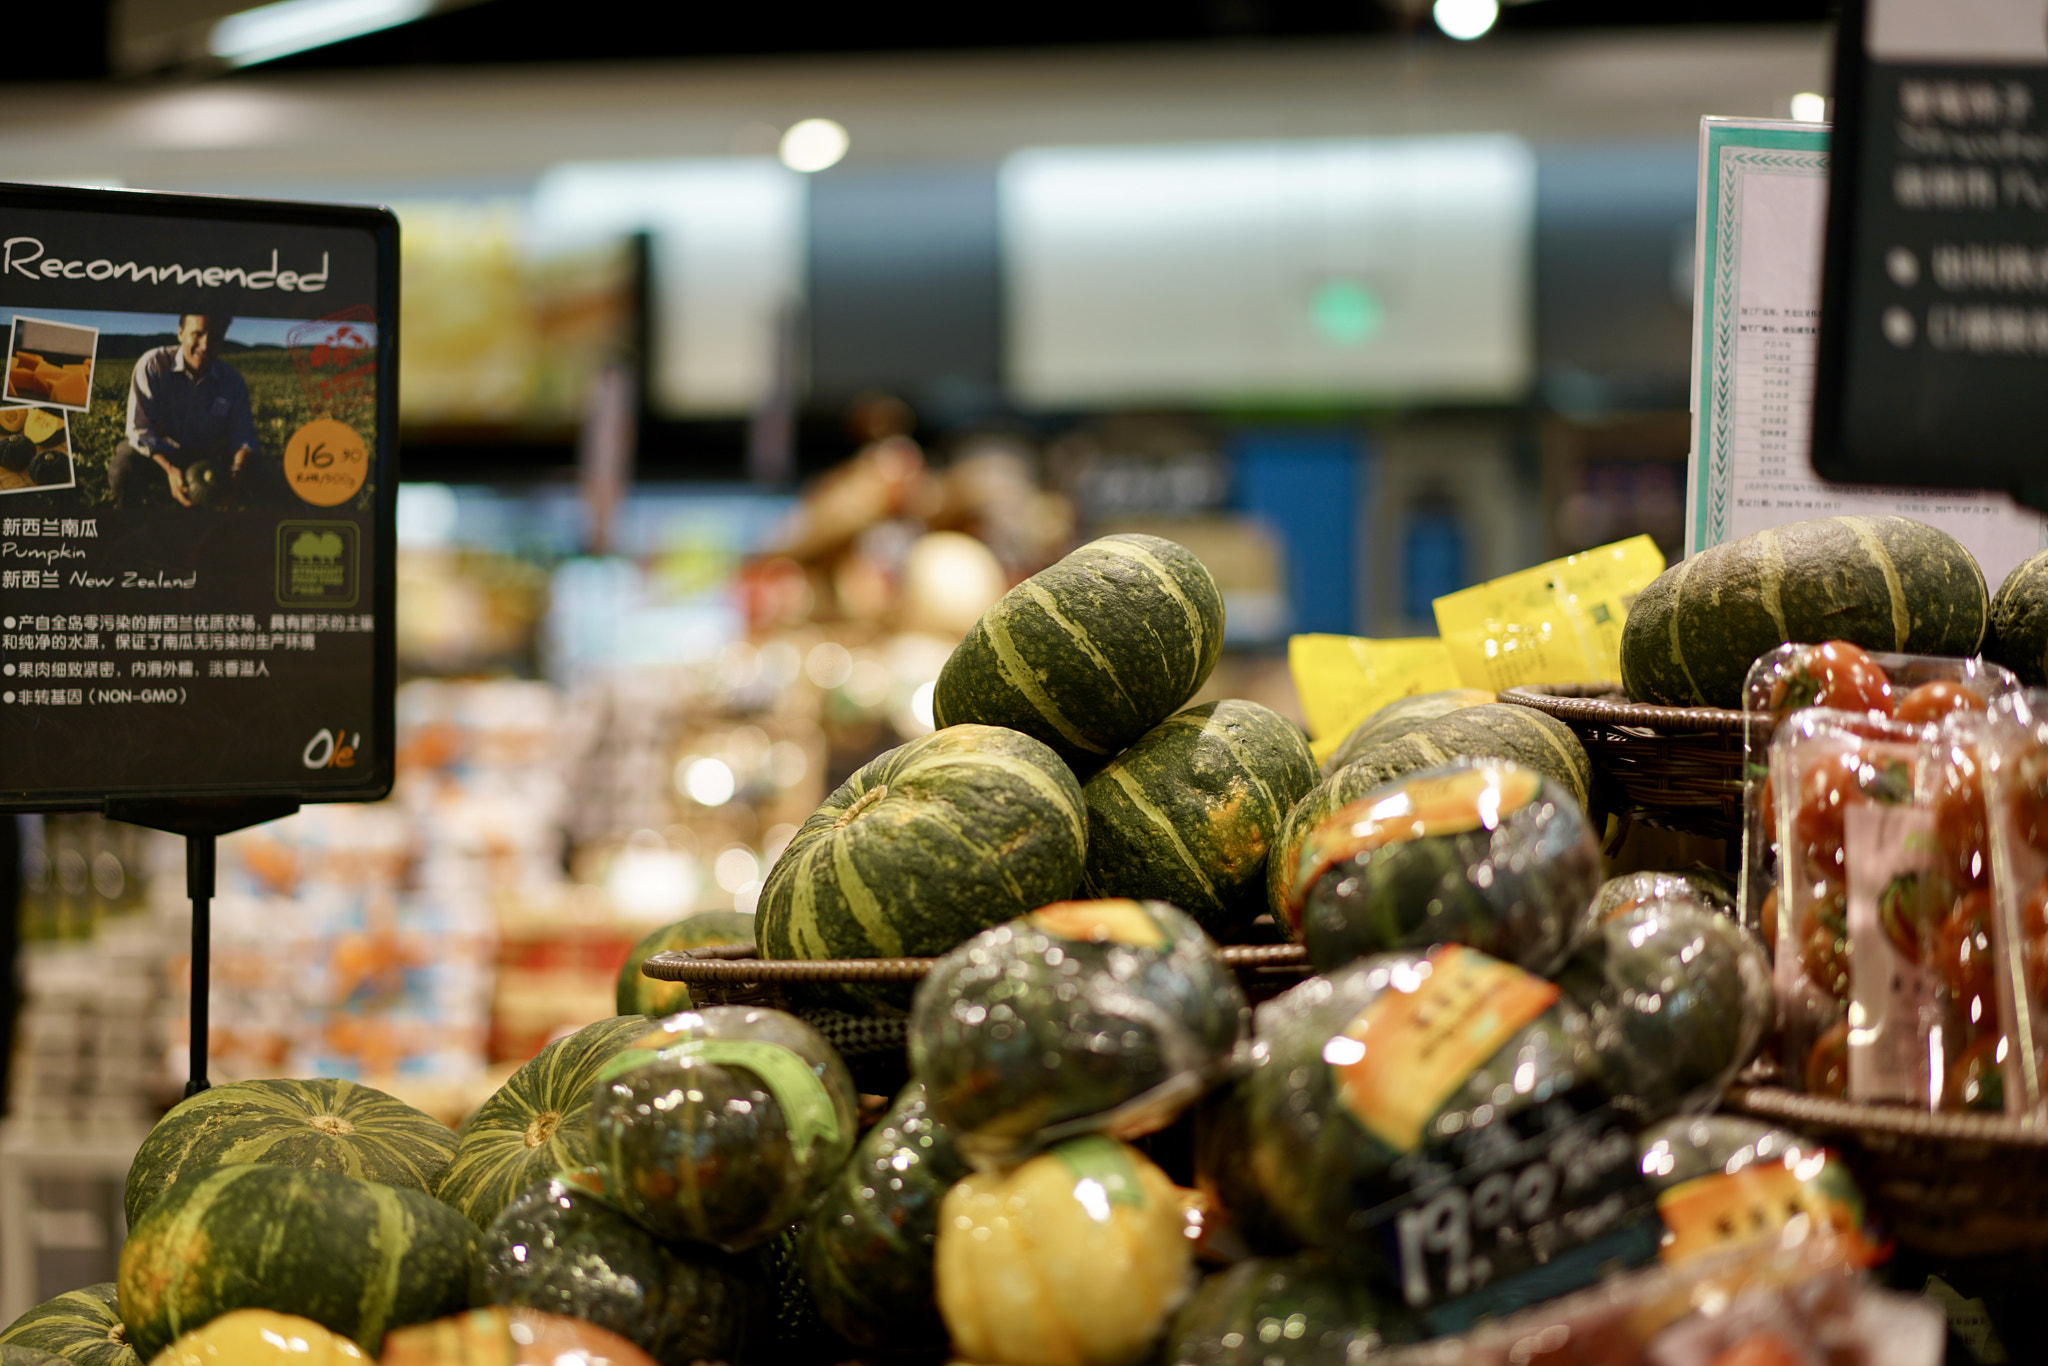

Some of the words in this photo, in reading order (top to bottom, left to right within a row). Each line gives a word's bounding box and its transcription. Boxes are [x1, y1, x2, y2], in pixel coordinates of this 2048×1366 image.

[4, 236, 329, 292] Recommended
[303, 441, 335, 469] 16
[2, 518, 98, 538] 新西兰南瓜
[2, 542, 86, 566] Pumpkin
[2, 570, 60, 589] 新西兰
[69, 570, 115, 588] New
[121, 570, 197, 589] Zealand
